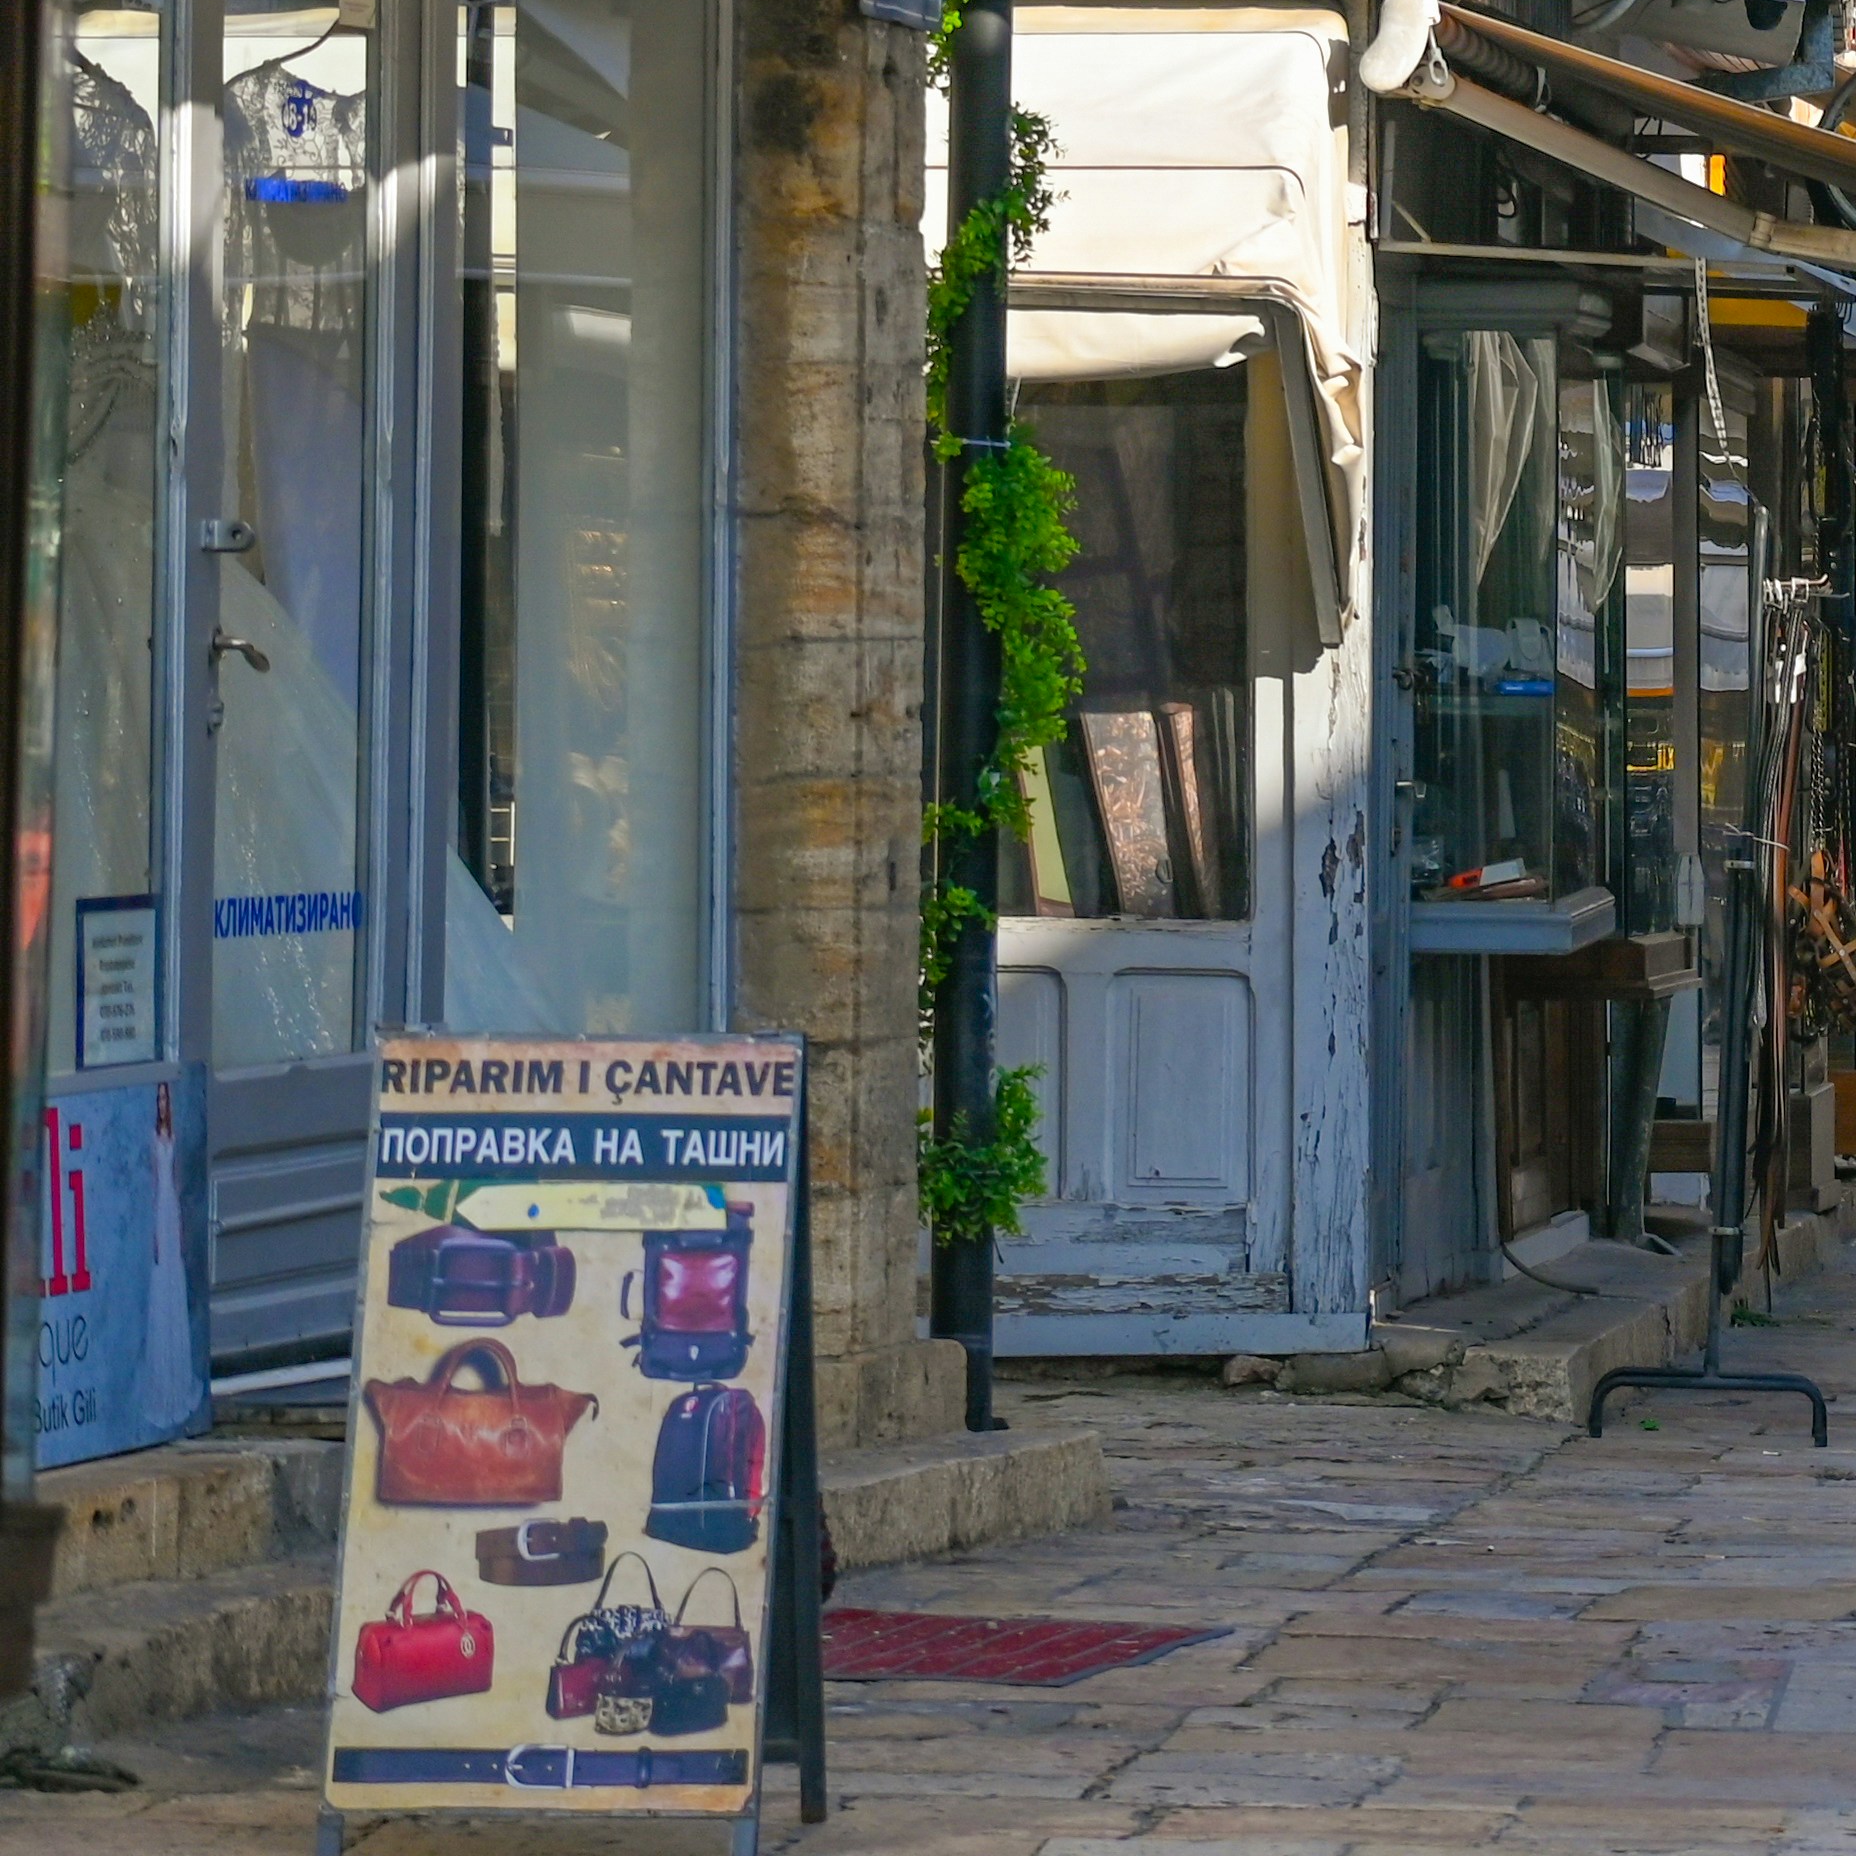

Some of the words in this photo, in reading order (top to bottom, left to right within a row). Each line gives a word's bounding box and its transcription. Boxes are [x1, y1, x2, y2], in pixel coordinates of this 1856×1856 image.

[214, 890, 362, 938] КЛИМАТИЗИРАНО
[381, 1058, 565, 1095] RIPARIM
[578, 1059, 592, 1094] I
[605, 1060, 795, 1106] ÇANTAVE
[381, 1127, 577, 1165] ПОПРАВКА
[593, 1128, 645, 1165] НА
[661, 1129, 785, 1167] ТАШНИ
[40, 1106, 92, 1296] li
[72, 1389, 98, 1426] Gili
